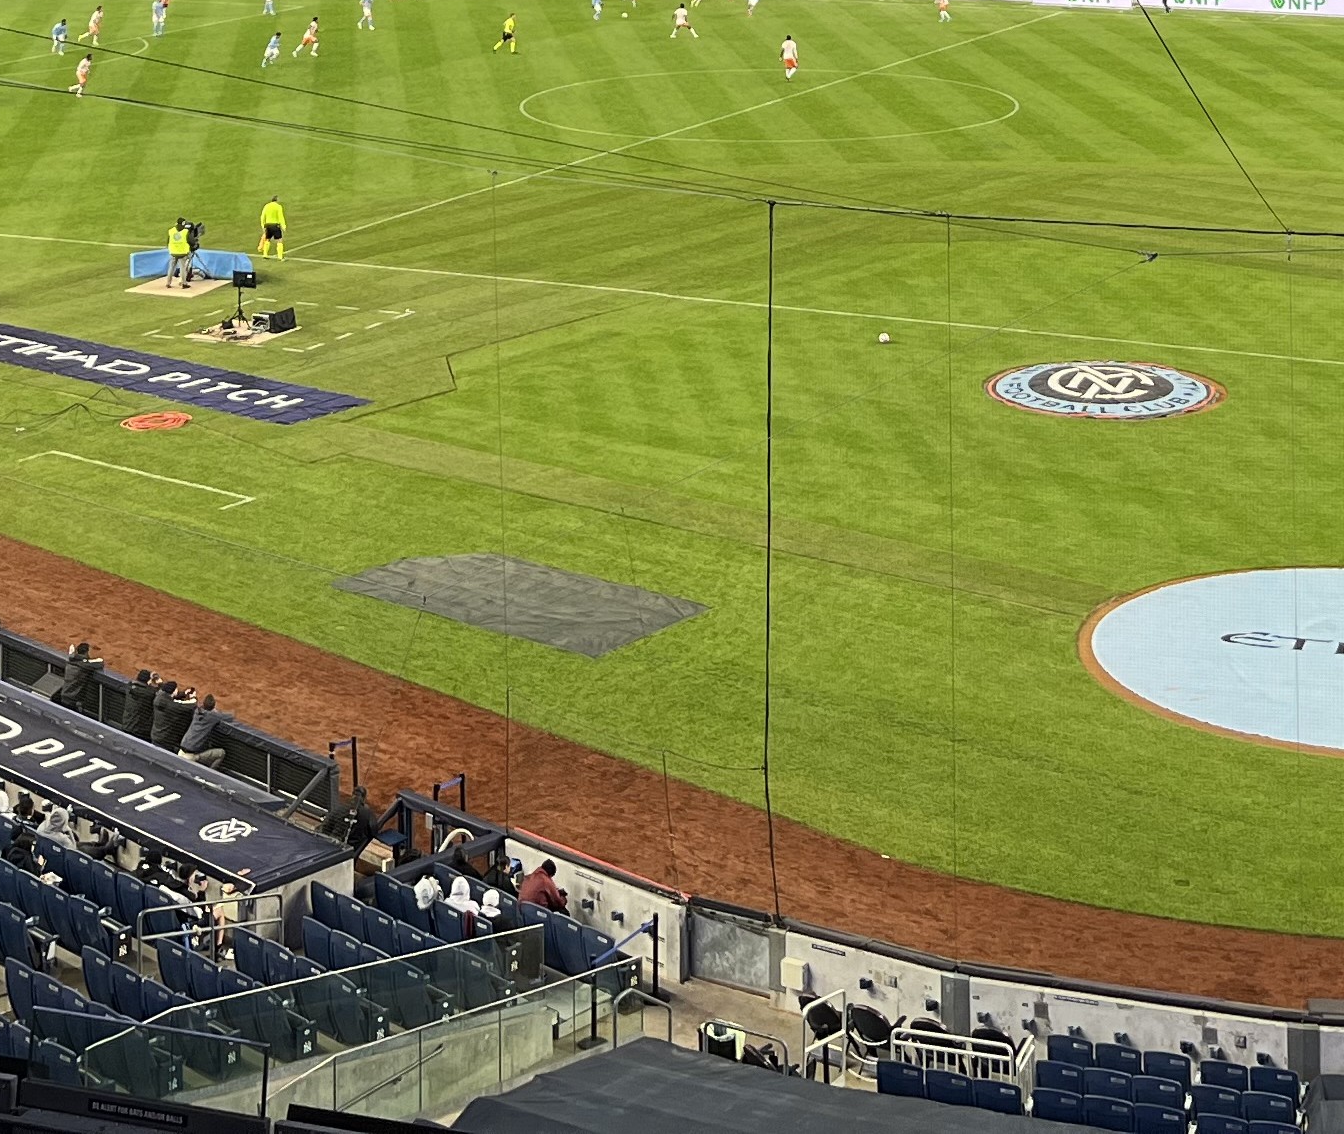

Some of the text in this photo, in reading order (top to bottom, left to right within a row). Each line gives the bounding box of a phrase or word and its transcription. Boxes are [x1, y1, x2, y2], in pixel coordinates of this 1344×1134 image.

[147, 371, 305, 409] PITCH
[1004, 383, 1190, 413] FOOTBALL CLUB
[11, 736, 182, 813] PITCH
[101, 1103, 116, 1113] ALERT
[118, 1106, 128, 1114] FOR
[166, 1114, 183, 1124] BALLS
